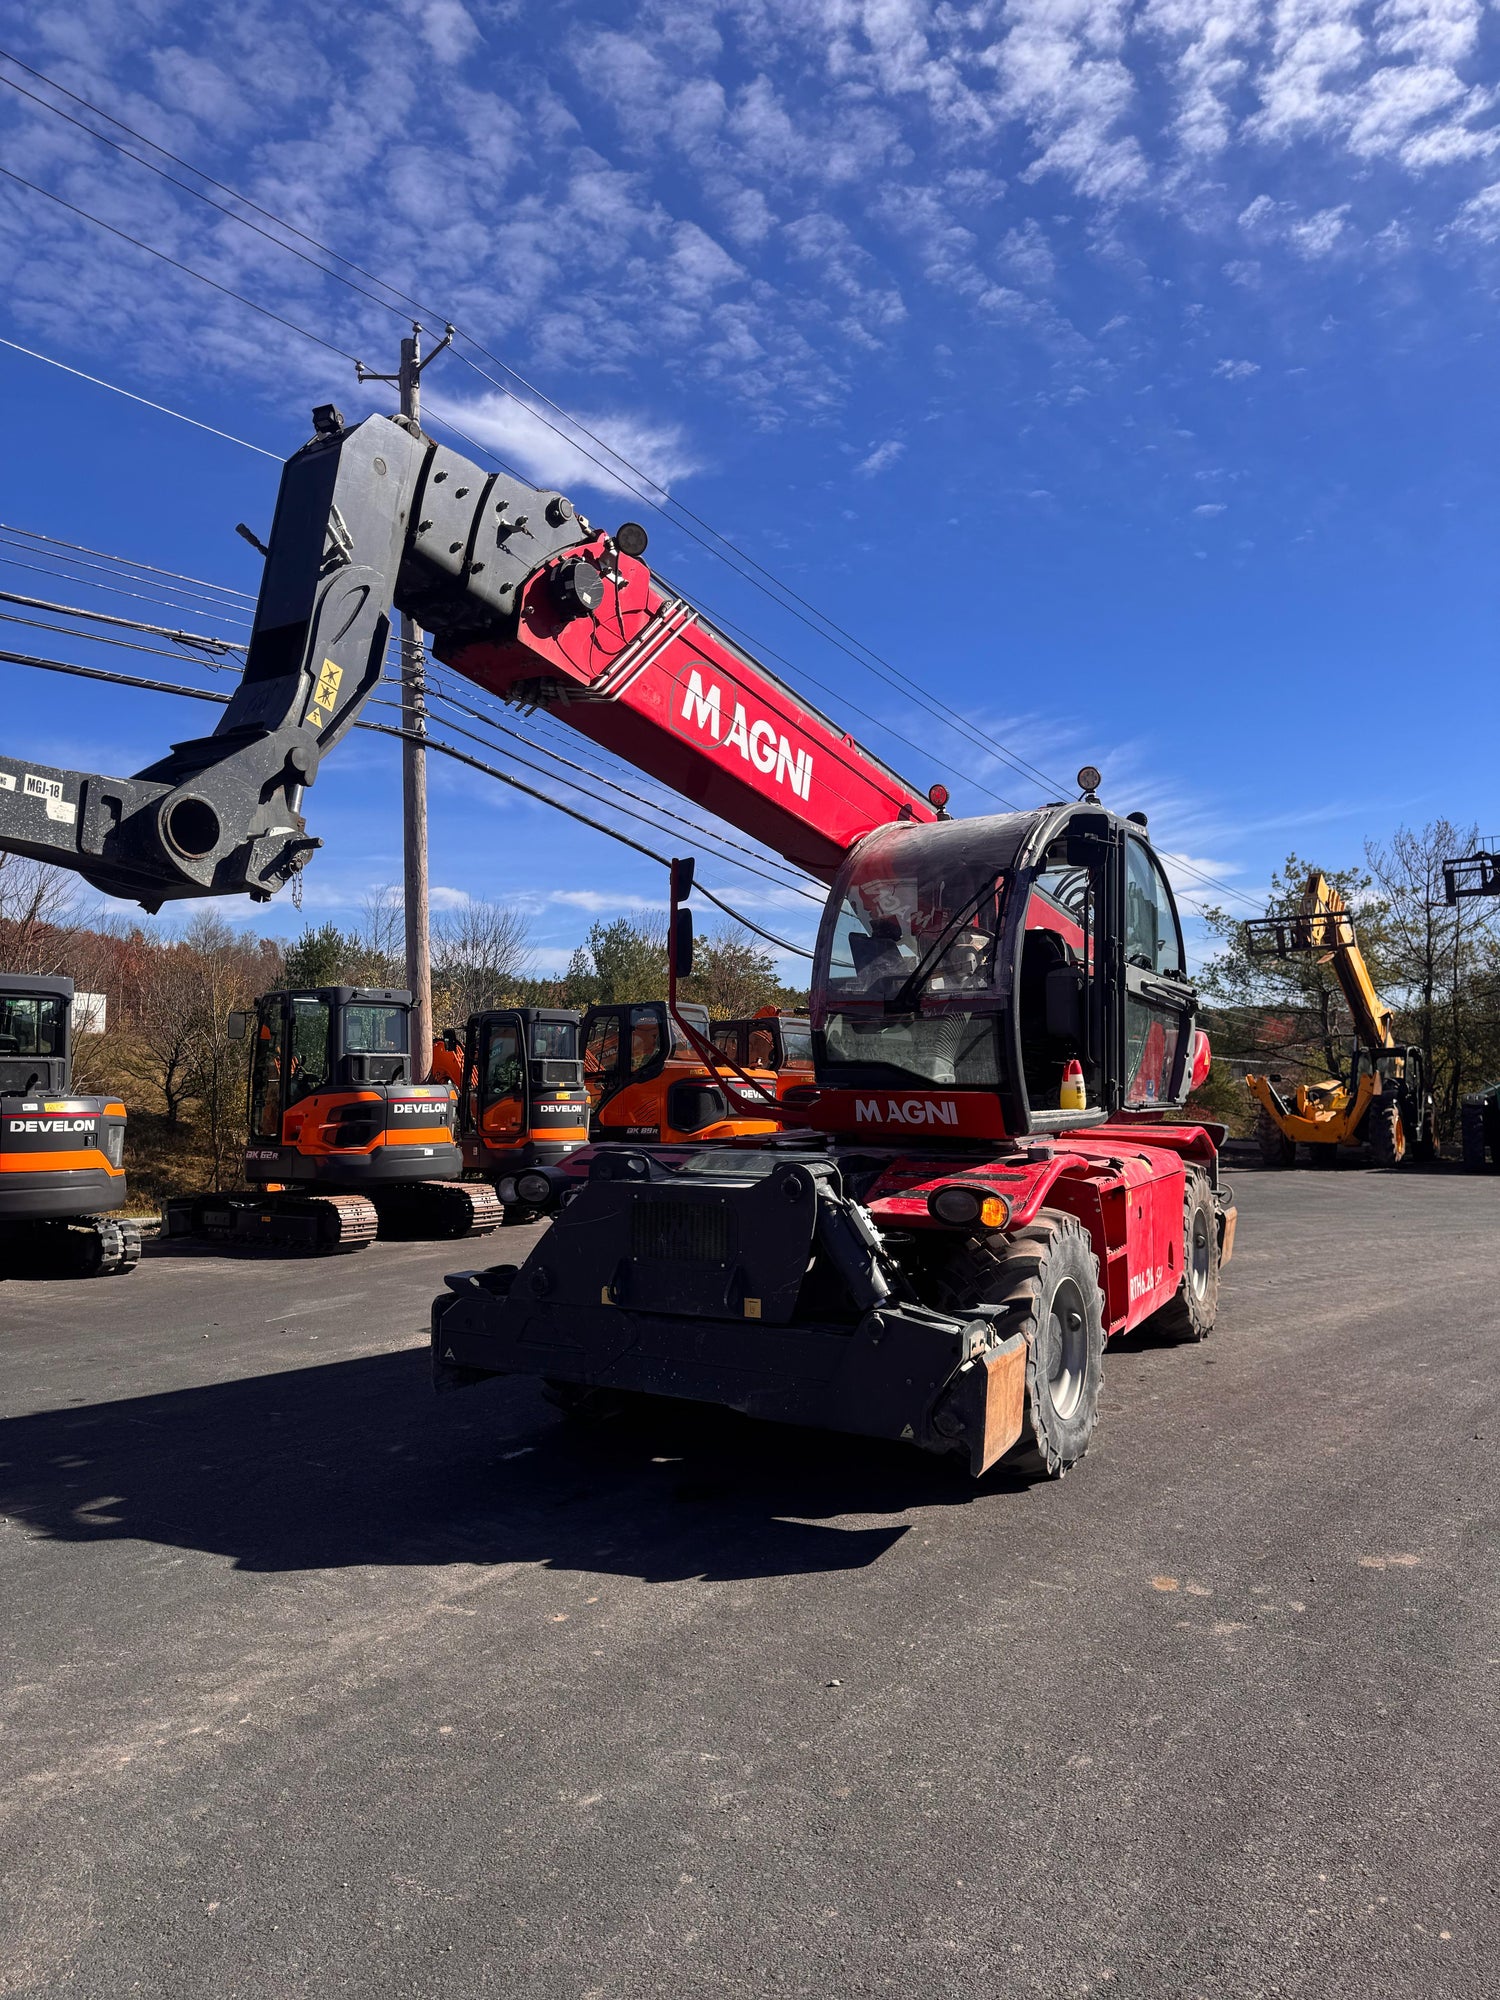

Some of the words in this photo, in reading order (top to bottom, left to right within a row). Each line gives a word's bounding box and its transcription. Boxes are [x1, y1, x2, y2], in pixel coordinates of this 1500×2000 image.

[681, 669, 814, 802] MAGNI
[27, 778, 60, 798] MGJ-18
[393, 1102, 447, 1114] DEVELON
[540, 1104, 582, 1113] DEVELON
[855, 1099, 959, 1125] MAGNI
[10, 1120, 95, 1132] DEVELON
